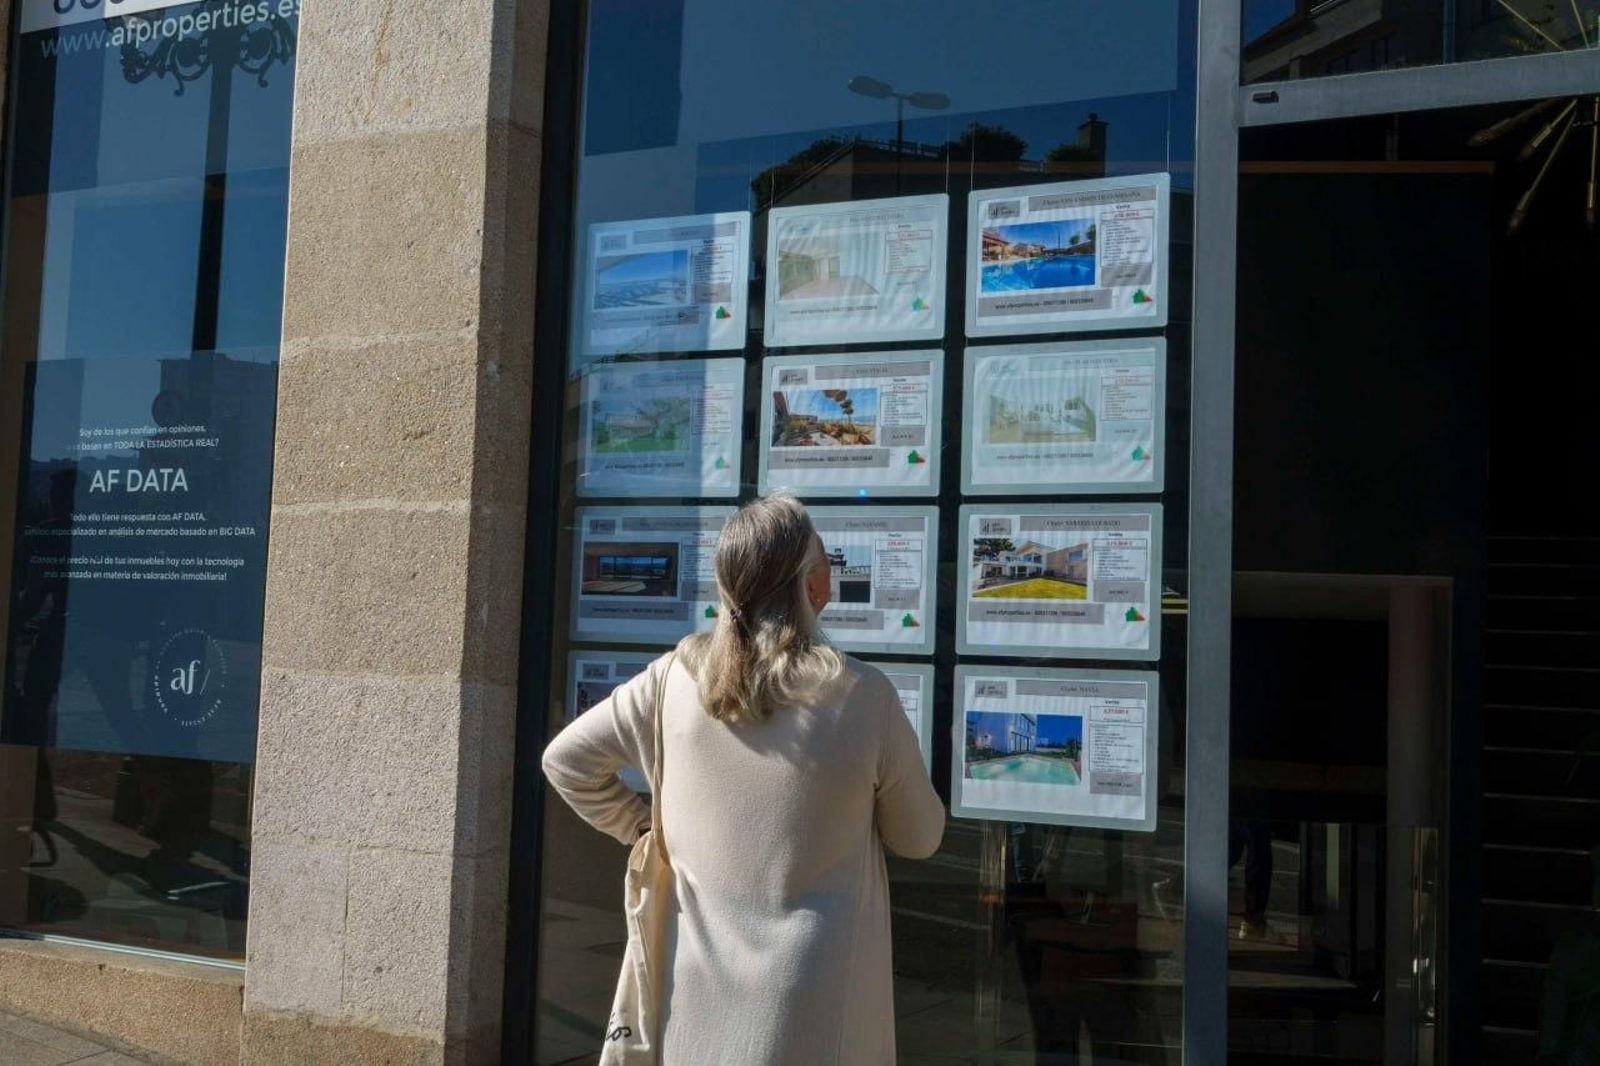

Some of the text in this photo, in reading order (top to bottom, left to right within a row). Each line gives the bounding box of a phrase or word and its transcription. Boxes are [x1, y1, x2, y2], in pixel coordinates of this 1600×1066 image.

[79, 427, 92, 437] Soy
[92, 427, 103, 436] de
[103, 427, 114, 436] los
[115, 427, 129, 437] que
[158, 426, 168, 434] en
[114, 440, 135, 449] TODA
[136, 440, 146, 449] LA
[195, 437, 220, 447] REAL?
[89, 467, 189, 493] AF DATA
[87, 512, 101, 521] ello
[102, 512, 120, 521] tiene
[120, 512, 156, 523] respuesta
[156, 513, 171, 521] con
[171, 512, 182, 521] AF
[135, 527, 145, 536] de
[145, 528, 179, 536] mercado
[179, 527, 207, 536] basado
[219, 526, 233, 536] BIG
[234, 526, 256, 536] DATA
[104, 557, 114, 565] de
[115, 557, 126, 565] tus
[127, 556, 165, 566] inmuebles
[165, 556, 181, 567] hoy
[181, 558, 196, 566] con
[196, 556, 204, 566] la
[92, 571, 103, 579] en
[103, 570, 131, 580] materia
[131, 571, 141, 580] de
[142, 571, 180, 581] valoración
[170, 659, 201, 695] af
